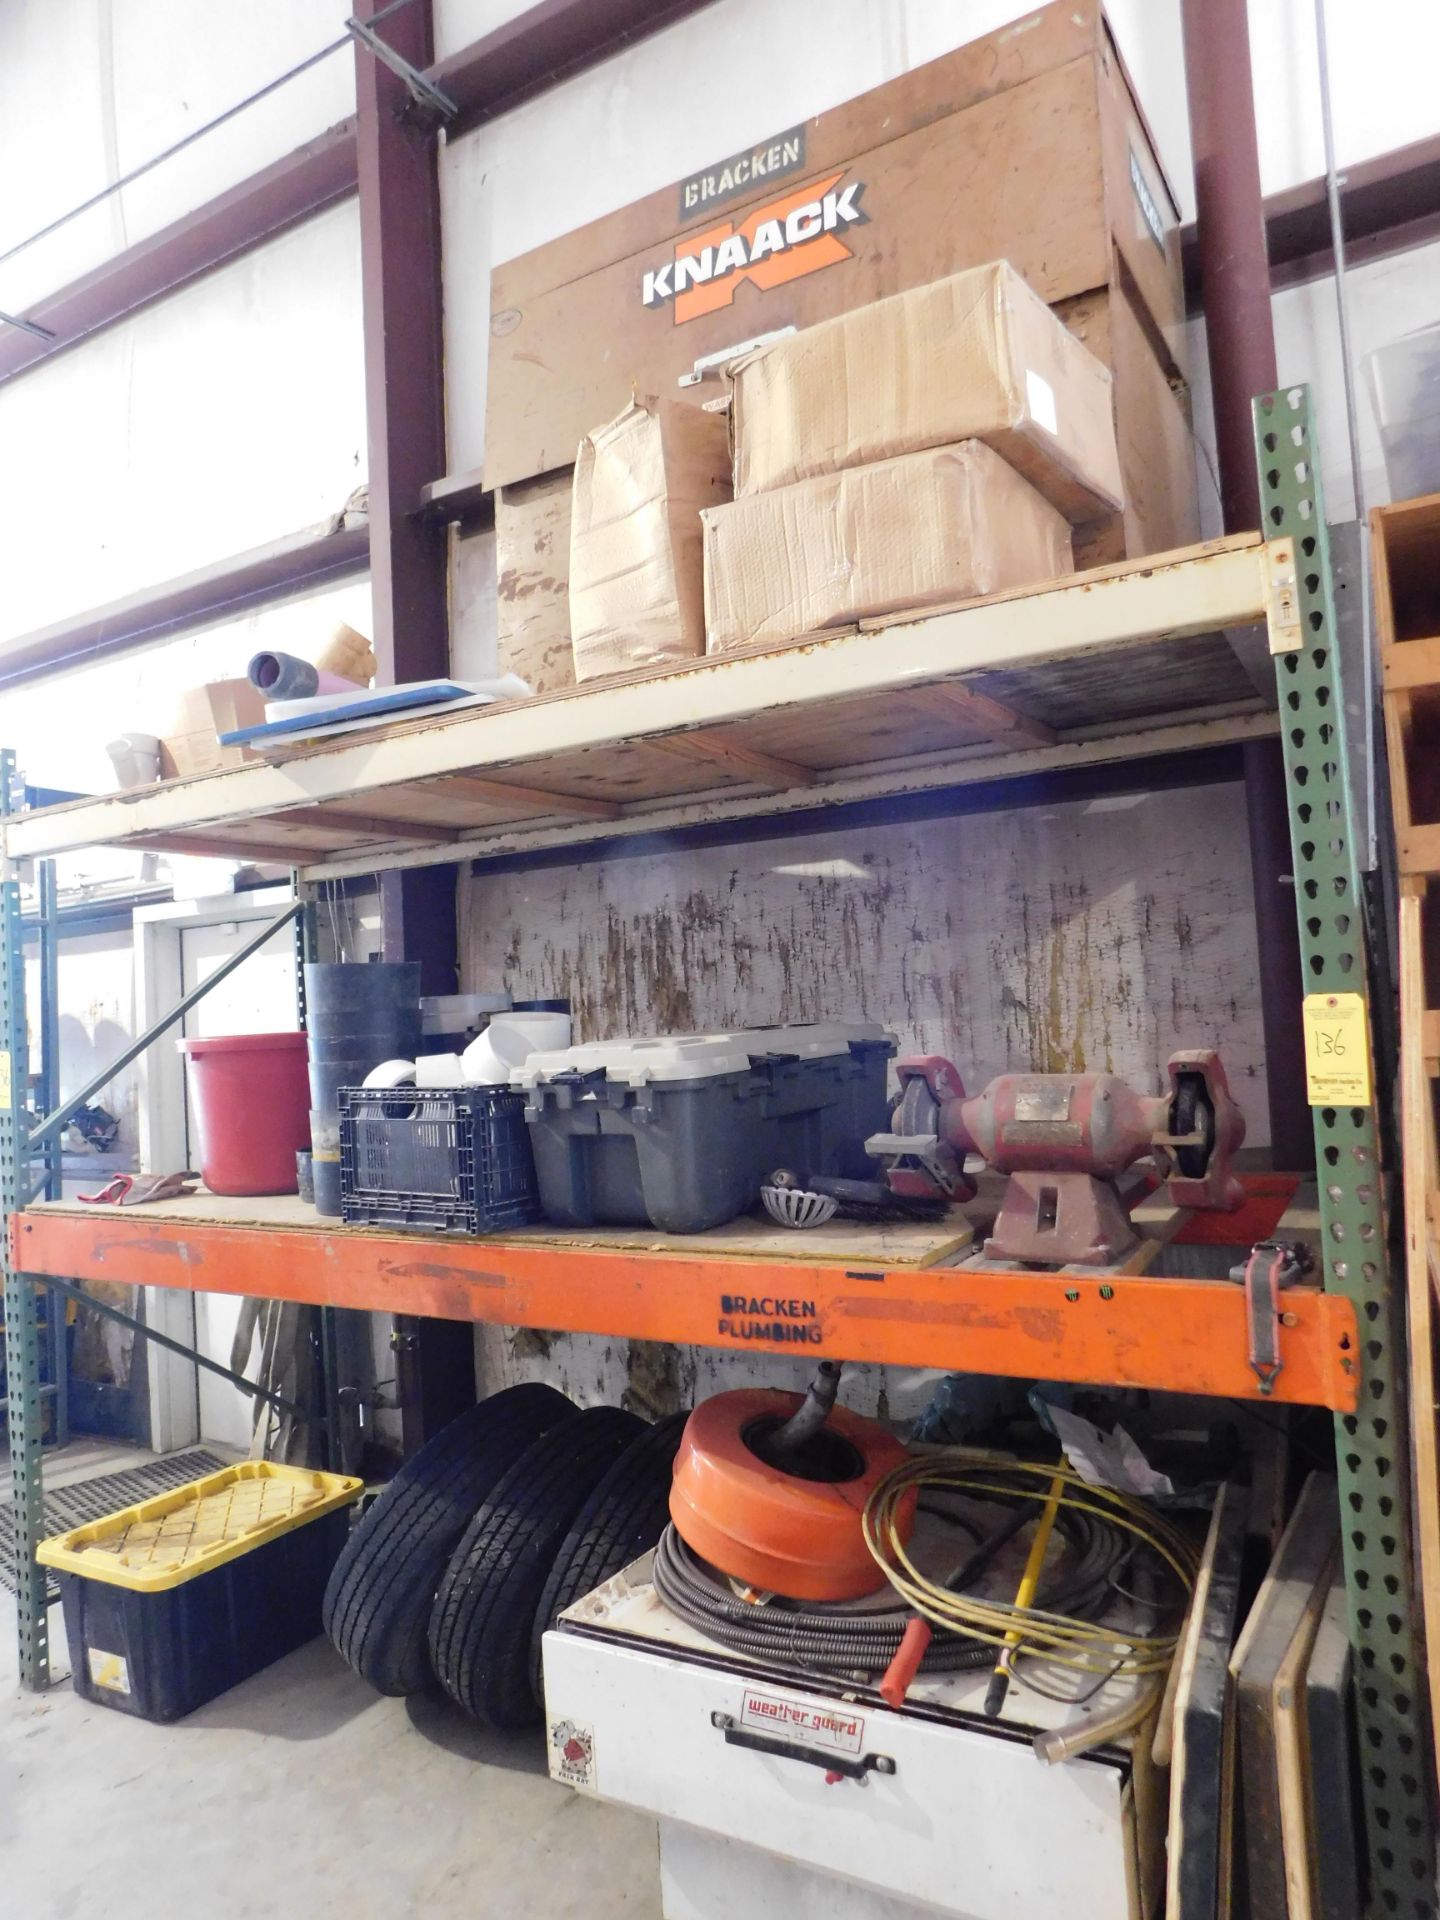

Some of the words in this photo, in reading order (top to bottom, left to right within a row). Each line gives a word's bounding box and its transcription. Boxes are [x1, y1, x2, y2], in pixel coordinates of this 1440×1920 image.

[684, 136, 800, 208] BRACKEN
[642, 182, 868, 307] KNAACK
[1314, 1028, 1346, 1057] 136
[720, 1295, 816, 1318] BRACKEN
[718, 1319, 822, 1344] PLUMBING
